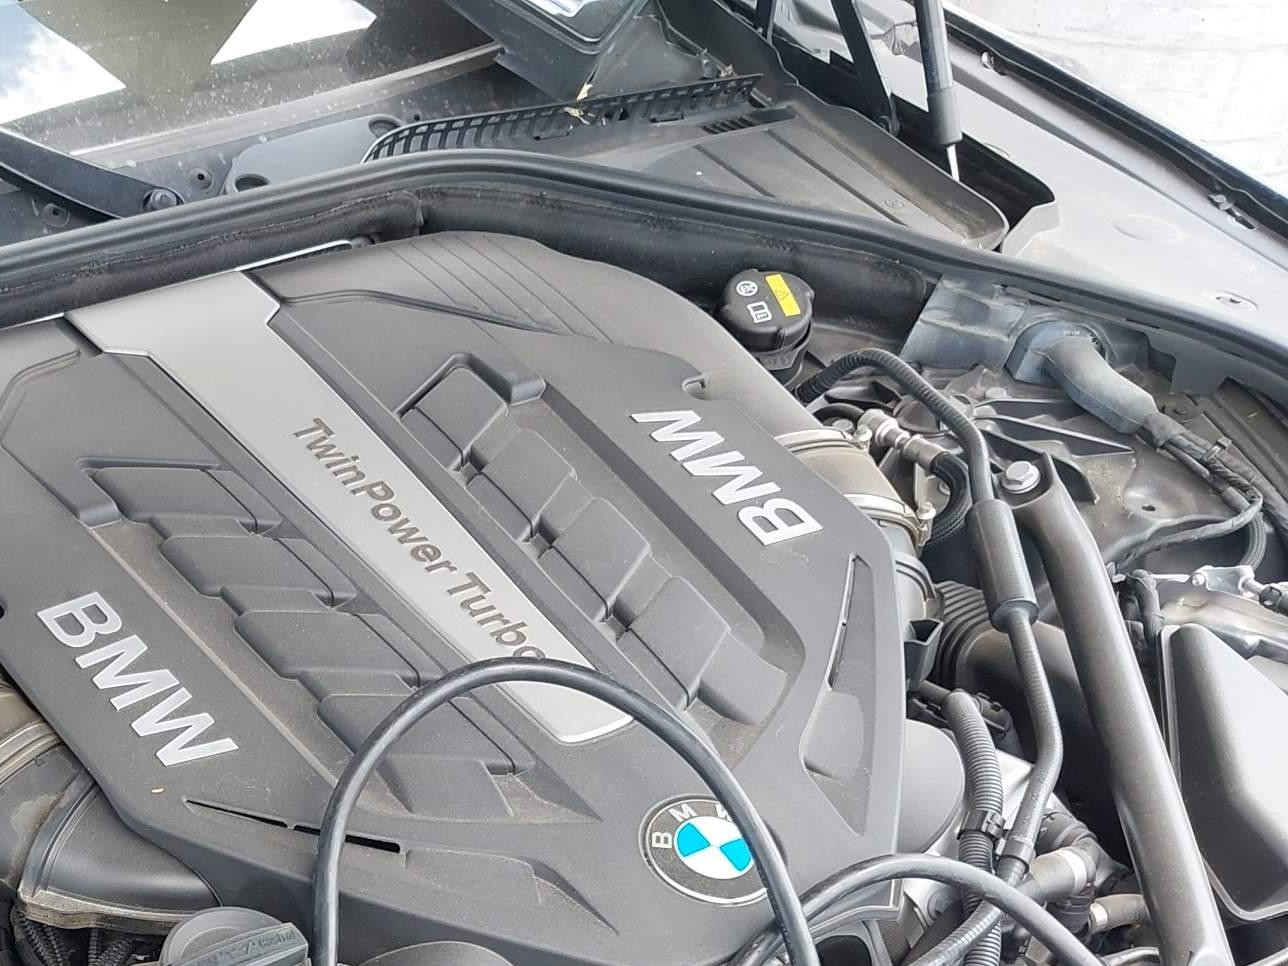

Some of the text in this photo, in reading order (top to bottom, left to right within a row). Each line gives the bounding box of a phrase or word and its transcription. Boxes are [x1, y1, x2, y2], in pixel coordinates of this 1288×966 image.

[293, 417, 458, 574] TwinPower
[630, 410, 824, 545] BMW
[36, 591, 239, 767] BMW
